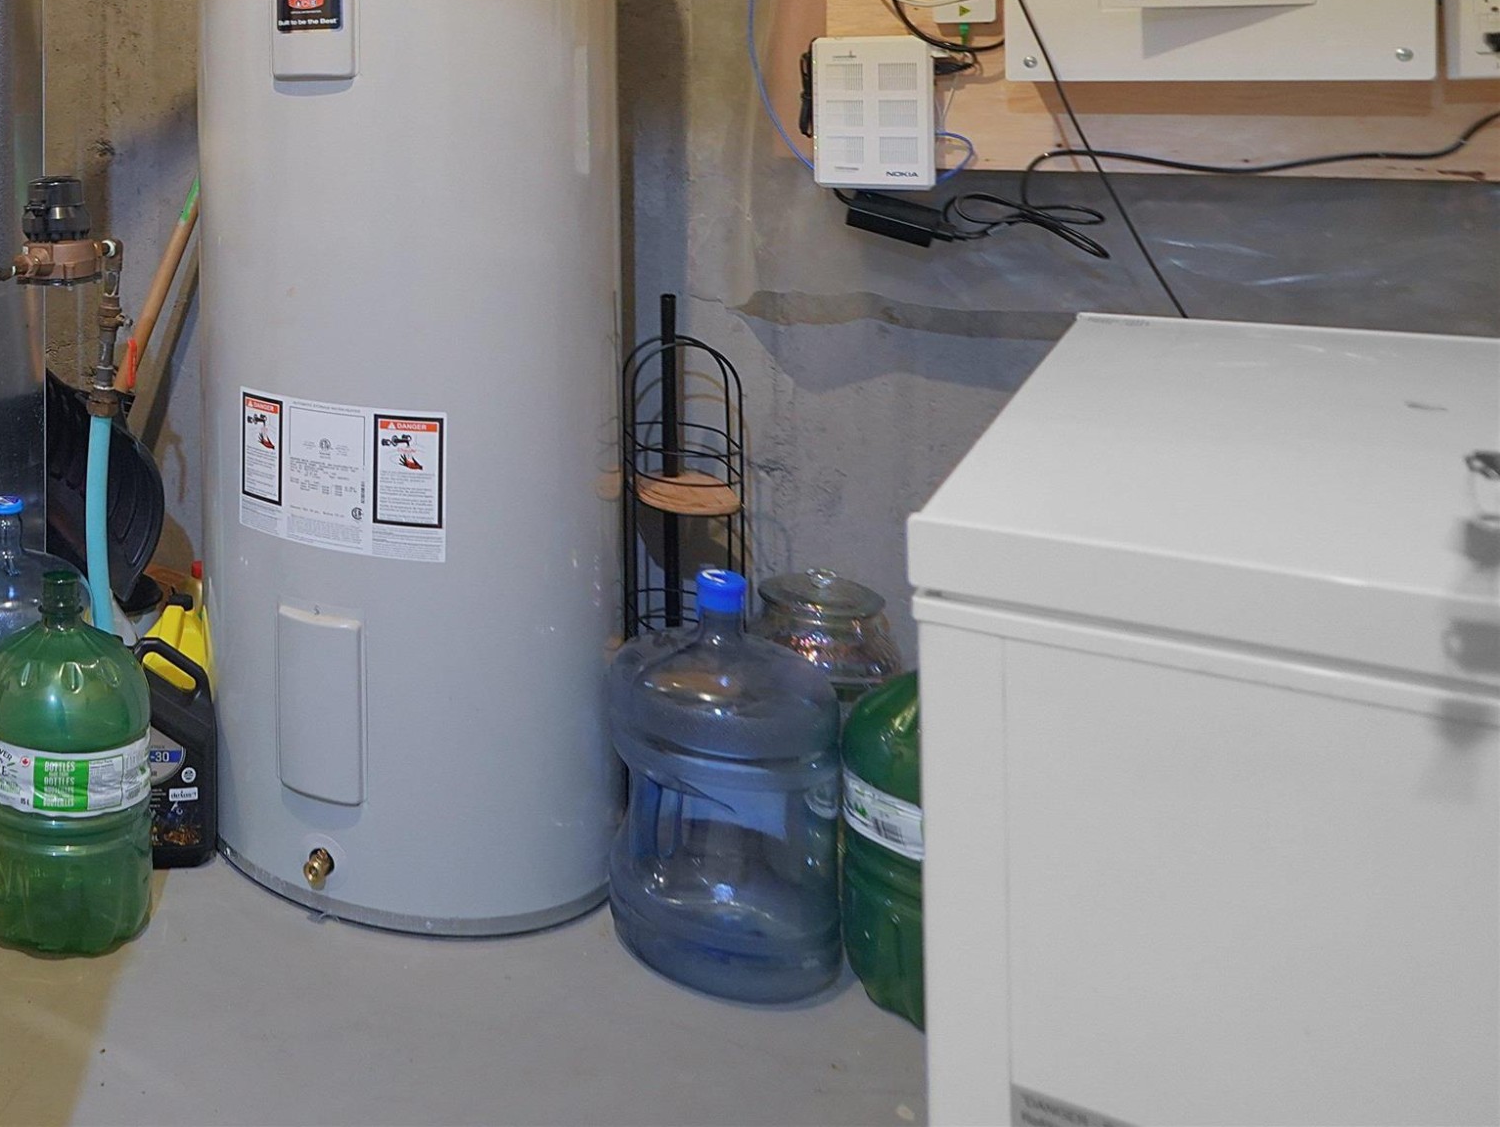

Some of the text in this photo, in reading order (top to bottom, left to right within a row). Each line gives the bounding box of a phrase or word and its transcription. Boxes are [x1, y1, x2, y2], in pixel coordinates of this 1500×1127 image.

[253, 400, 274, 411] DANGER
[396, 422, 427, 431] DANGER
[44, 760, 76, 773] BOTTLES
[43, 776, 75, 787] BOTTLES
